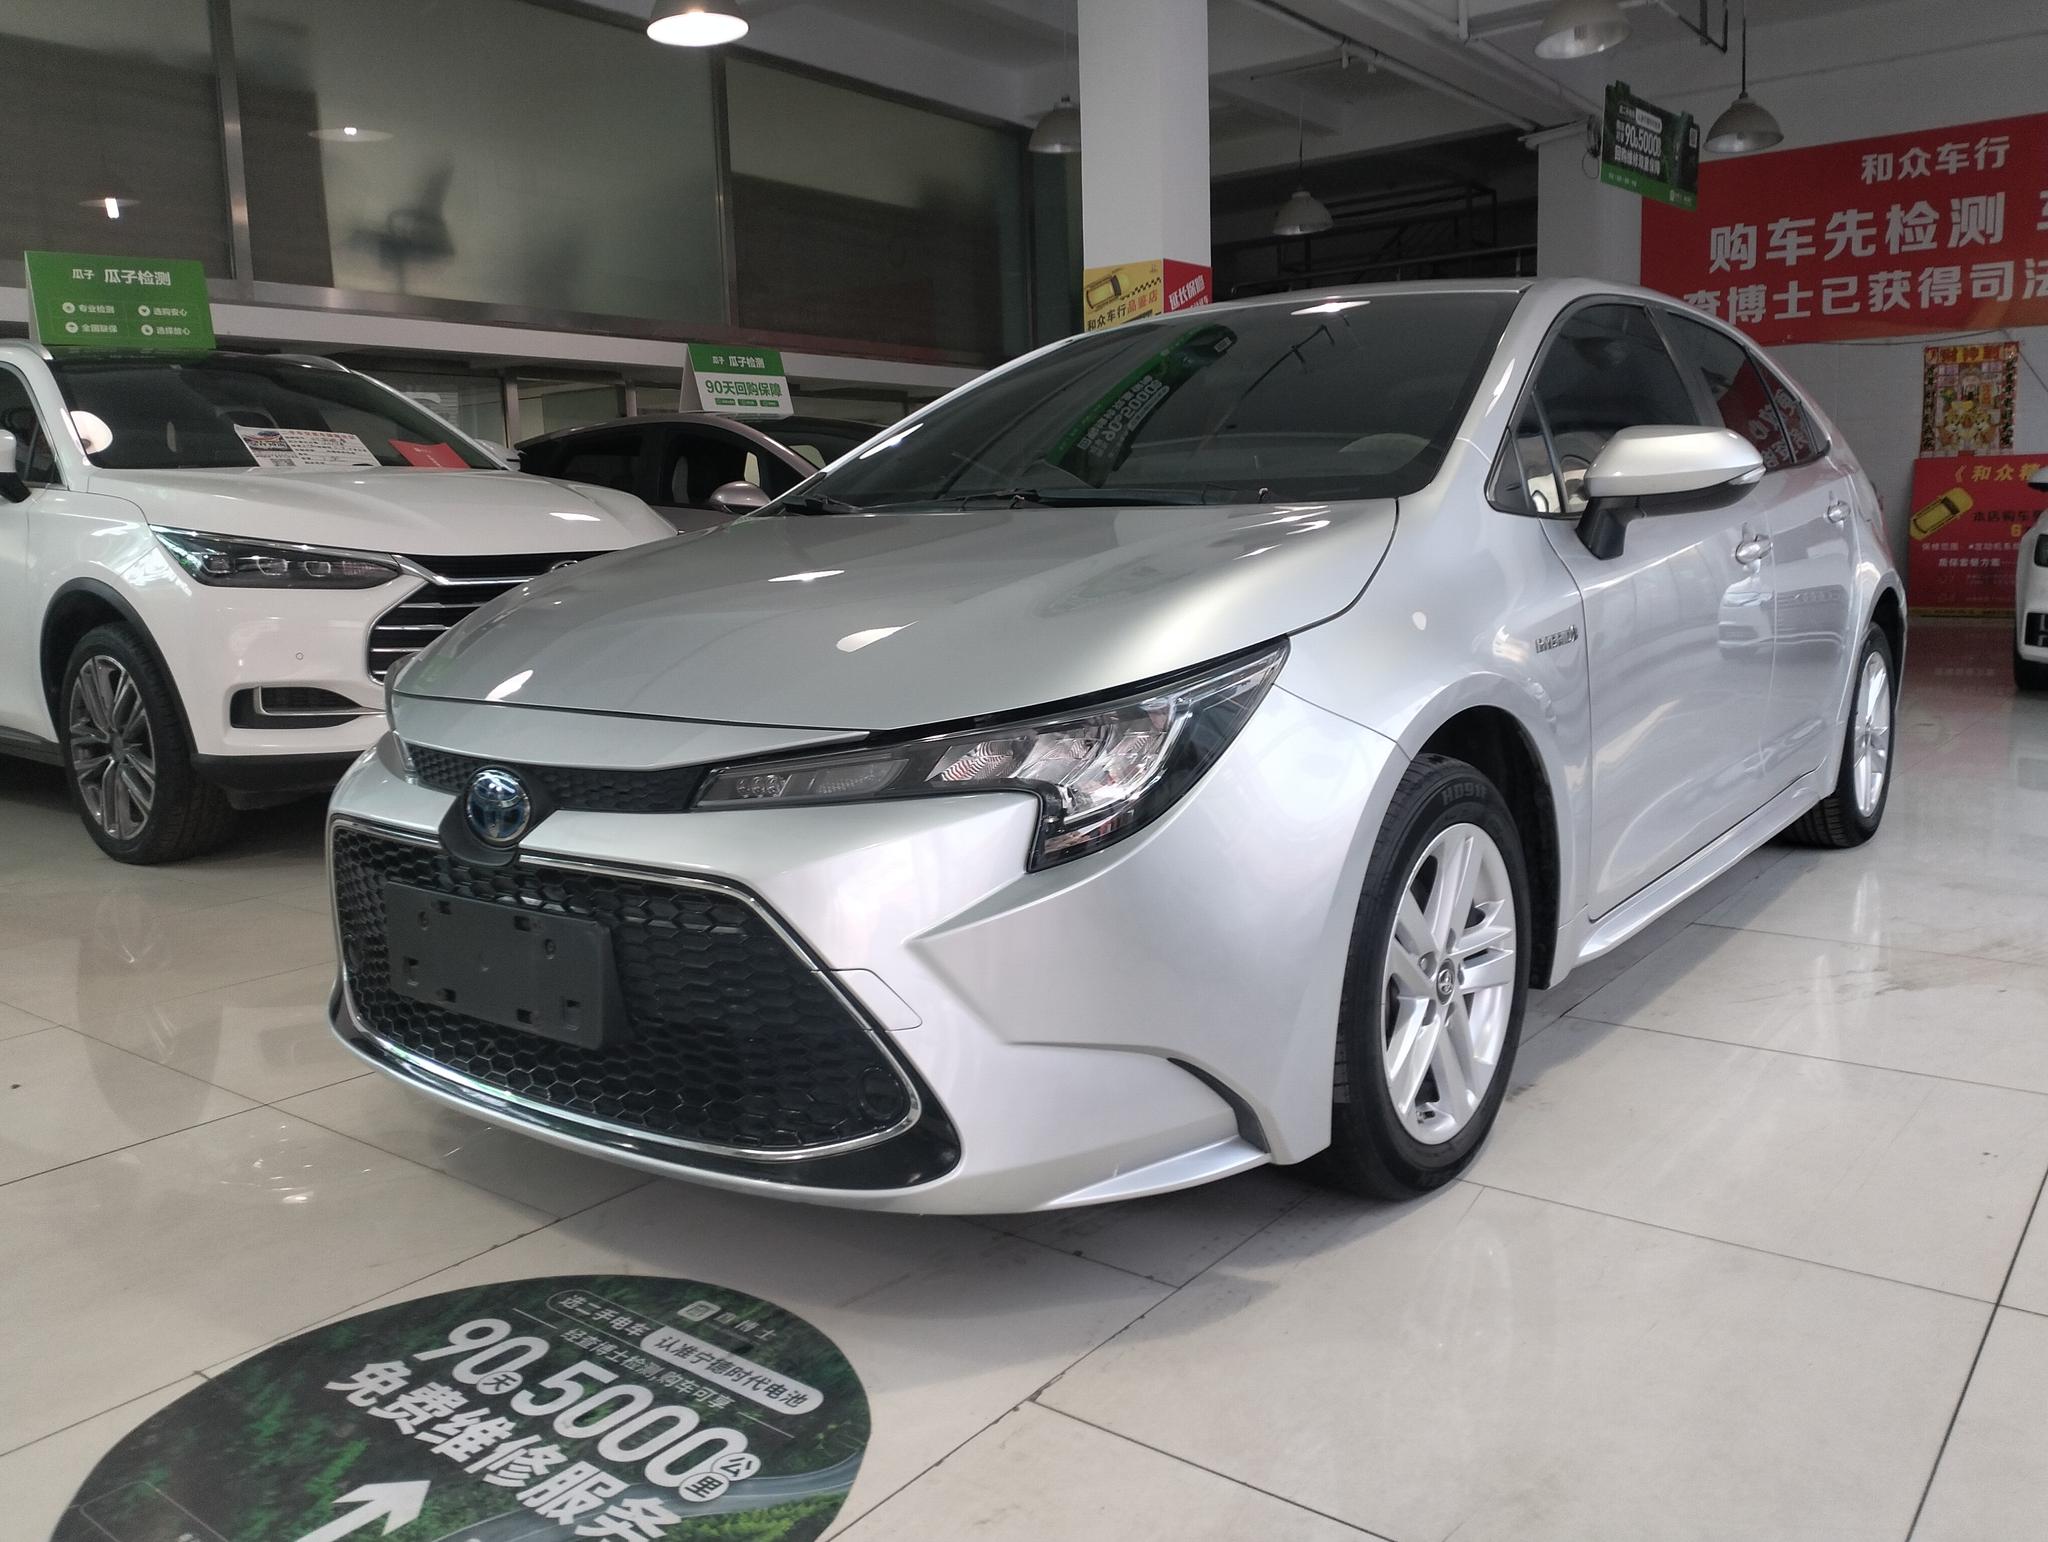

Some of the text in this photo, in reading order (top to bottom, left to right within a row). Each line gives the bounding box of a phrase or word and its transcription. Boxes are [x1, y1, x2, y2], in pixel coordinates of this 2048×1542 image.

[1861, 136, 2010, 185] 和众车行
[1709, 192, 2005, 274] 购车先检测
[72, 268, 171, 286] 瓜子 瓜子检测
[729, 356, 765, 369] 瓜子检测
[705, 380, 782, 397] 90天回购保障
[560, 1295, 809, 1407] 选二手电车 认准宁德时代电池
[325, 1359, 682, 1542] 免费维修服务
